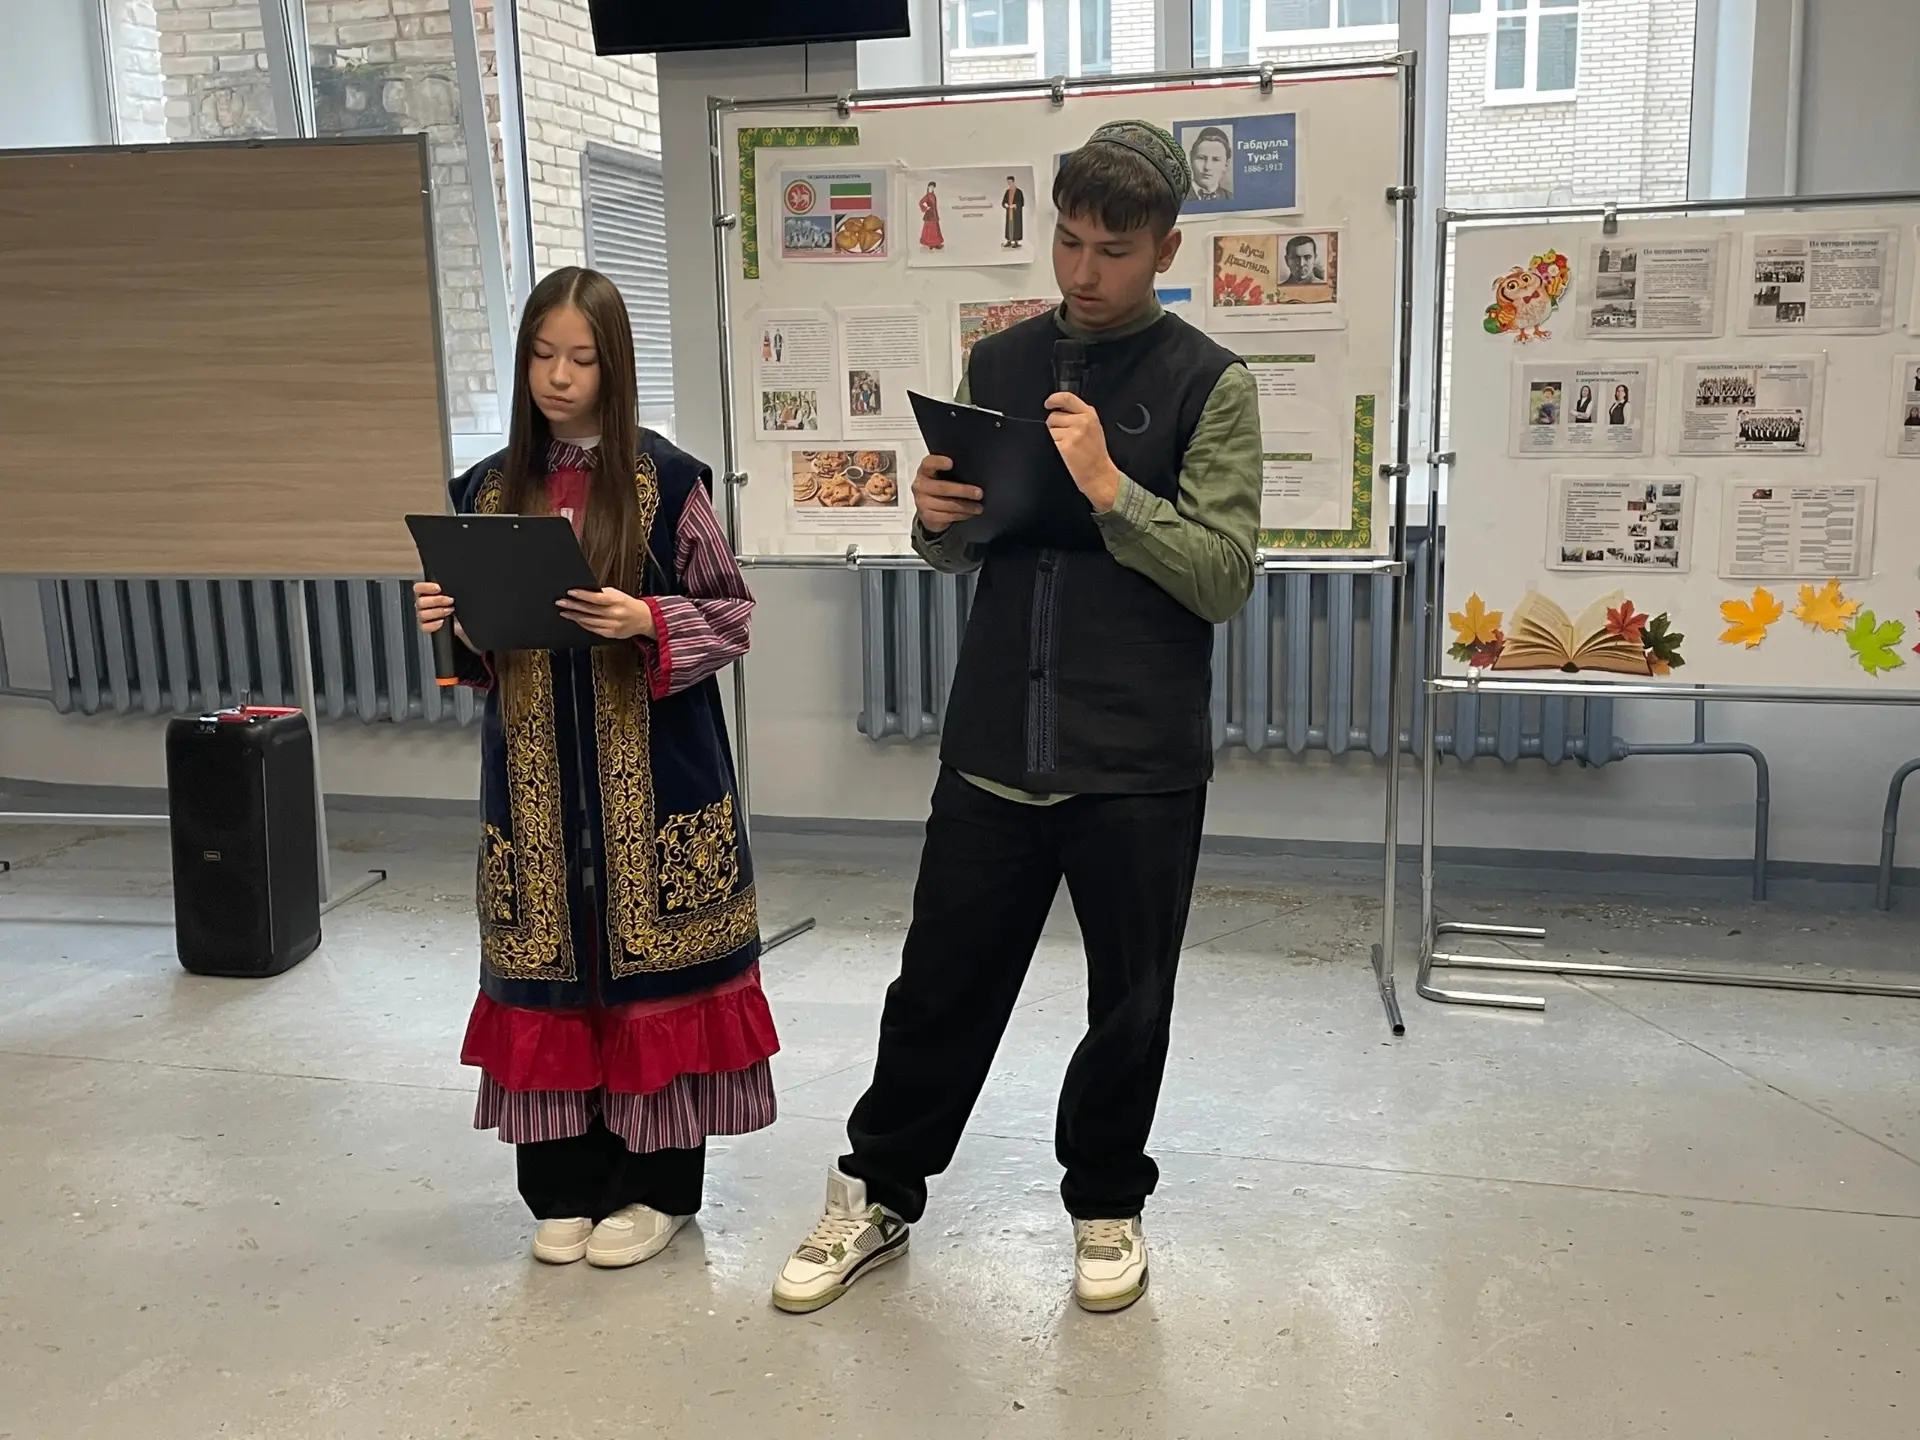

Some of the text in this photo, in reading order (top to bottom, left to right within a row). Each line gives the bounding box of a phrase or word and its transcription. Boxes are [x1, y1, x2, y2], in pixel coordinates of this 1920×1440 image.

[1237, 139, 1289, 150] Габдулла
[1247, 150, 1279, 163] Тукай
[1243, 162, 1283, 173] 1886-1913
[1239, 242, 1265, 259] Муса
[1224, 253, 1269, 274] Джалиль
